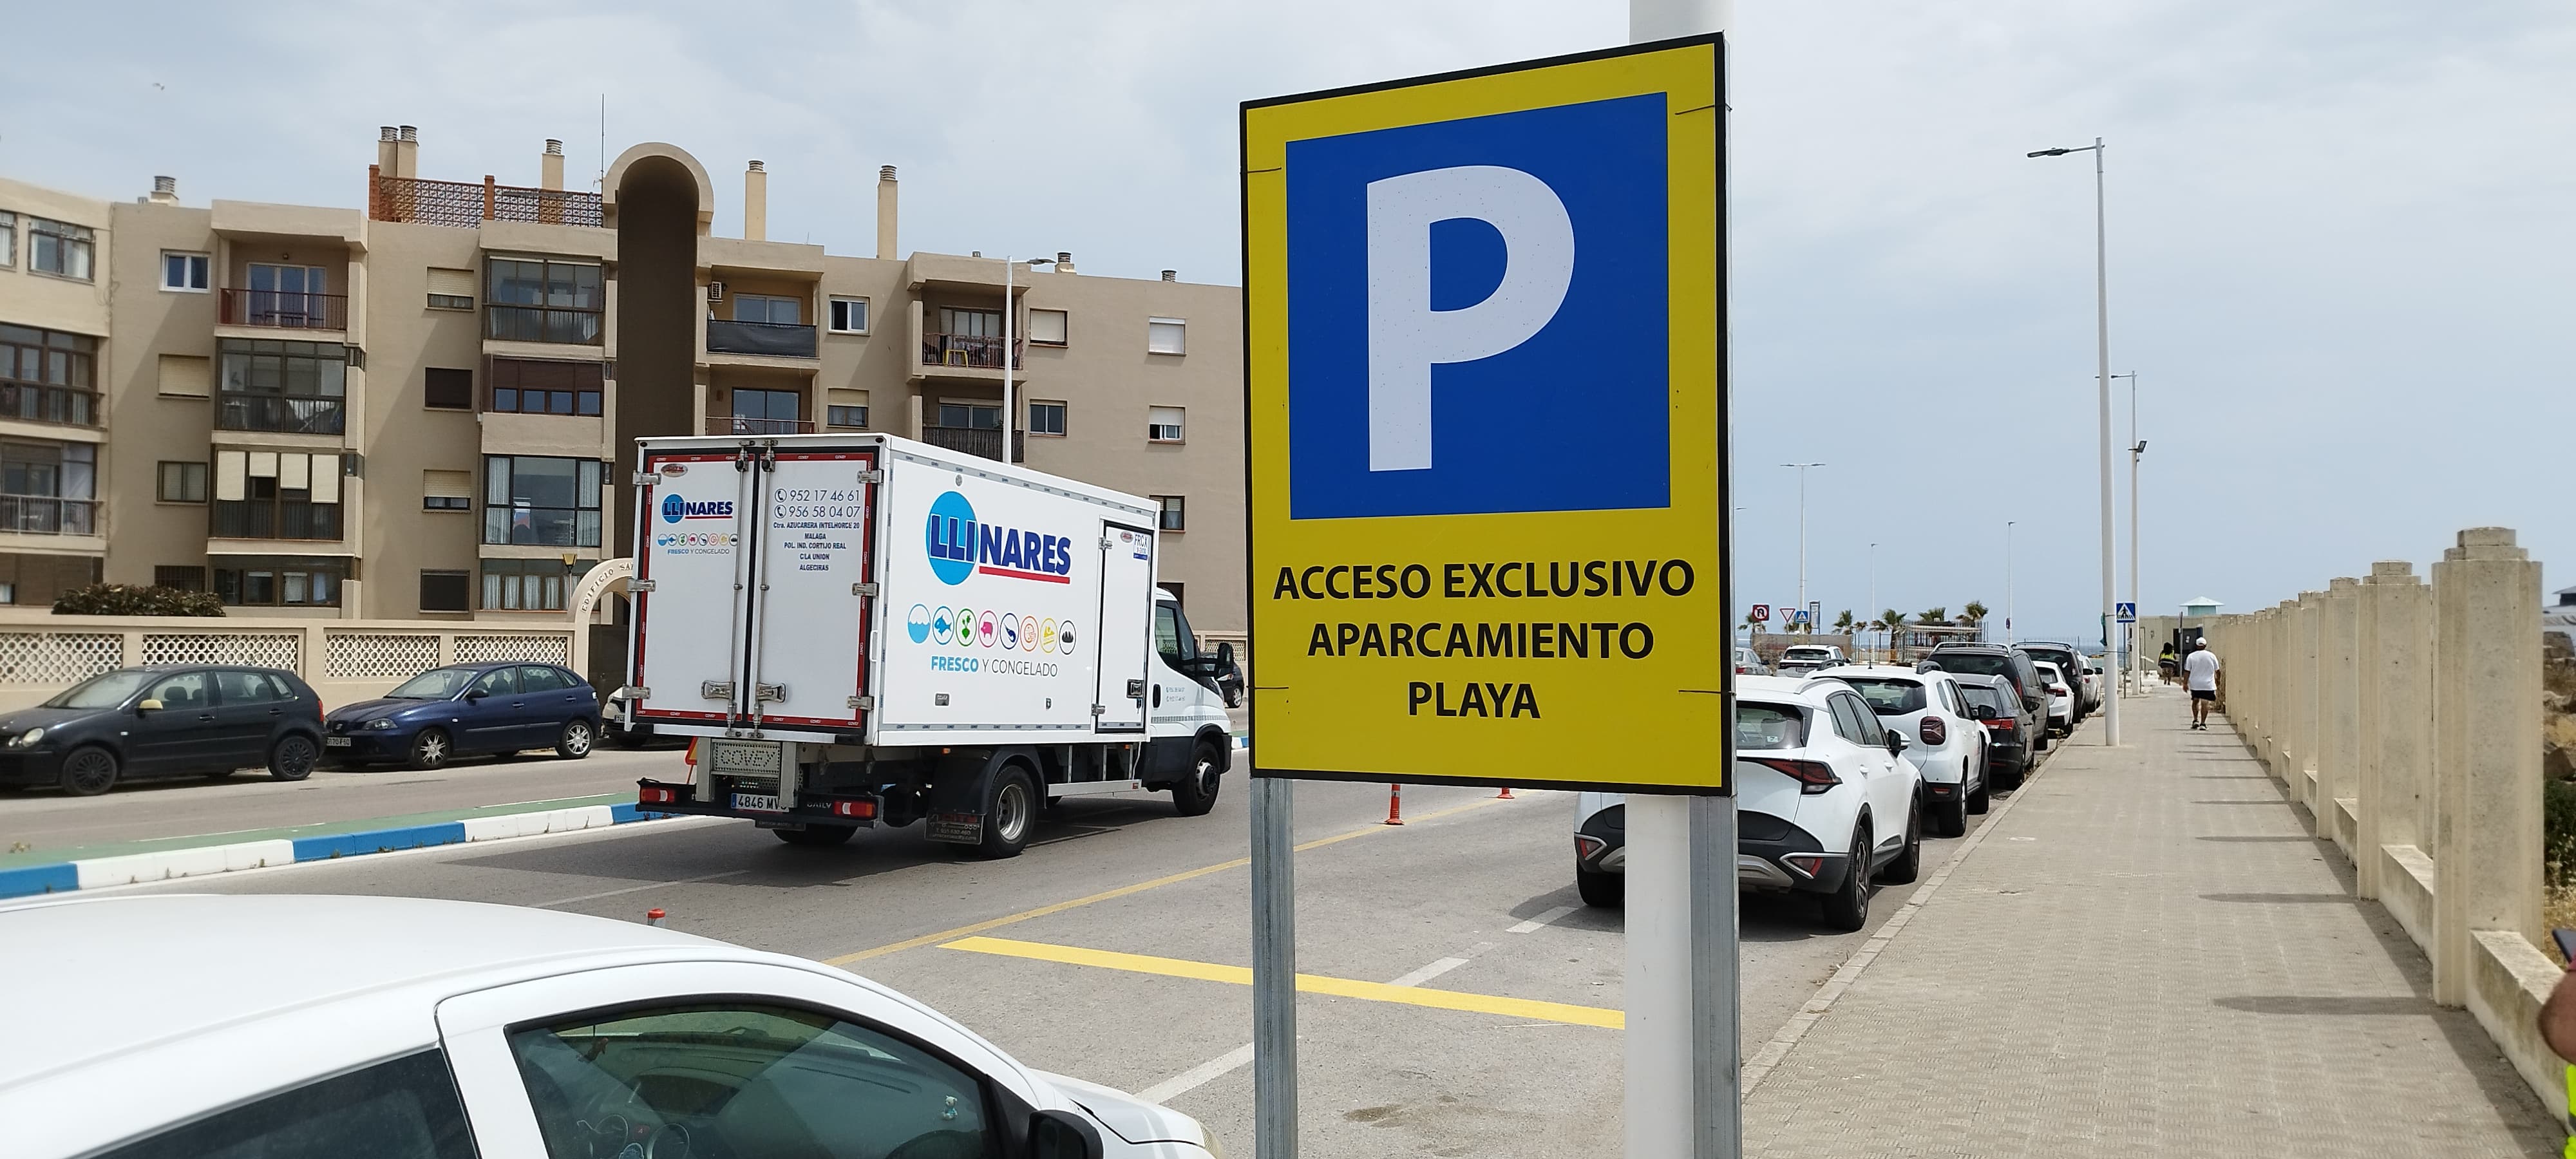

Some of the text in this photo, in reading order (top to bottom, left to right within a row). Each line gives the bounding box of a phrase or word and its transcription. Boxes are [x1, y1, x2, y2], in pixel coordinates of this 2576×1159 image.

[1367, 165, 1575, 473] P
[790, 489, 859, 501] 952 17 46 61
[663, 501, 733, 516] LLINARES
[789, 505, 860, 517] 956 58 04 07
[930, 514, 1071, 576] LLINARES
[1134, 534, 1148, 548] FRCX
[1273, 558, 1695, 600] ACCESO EXCLUSIVO
[582, 569, 614, 612] EDIFICIO
[1307, 621, 1654, 659] APARCAMIENTO
[931, 655, 1058, 677] FRESCO Y CONGELADO
[1408, 681, 1542, 719] PLAYA
[721, 749, 775, 768] COVEY
[738, 795, 764, 808] 4846
